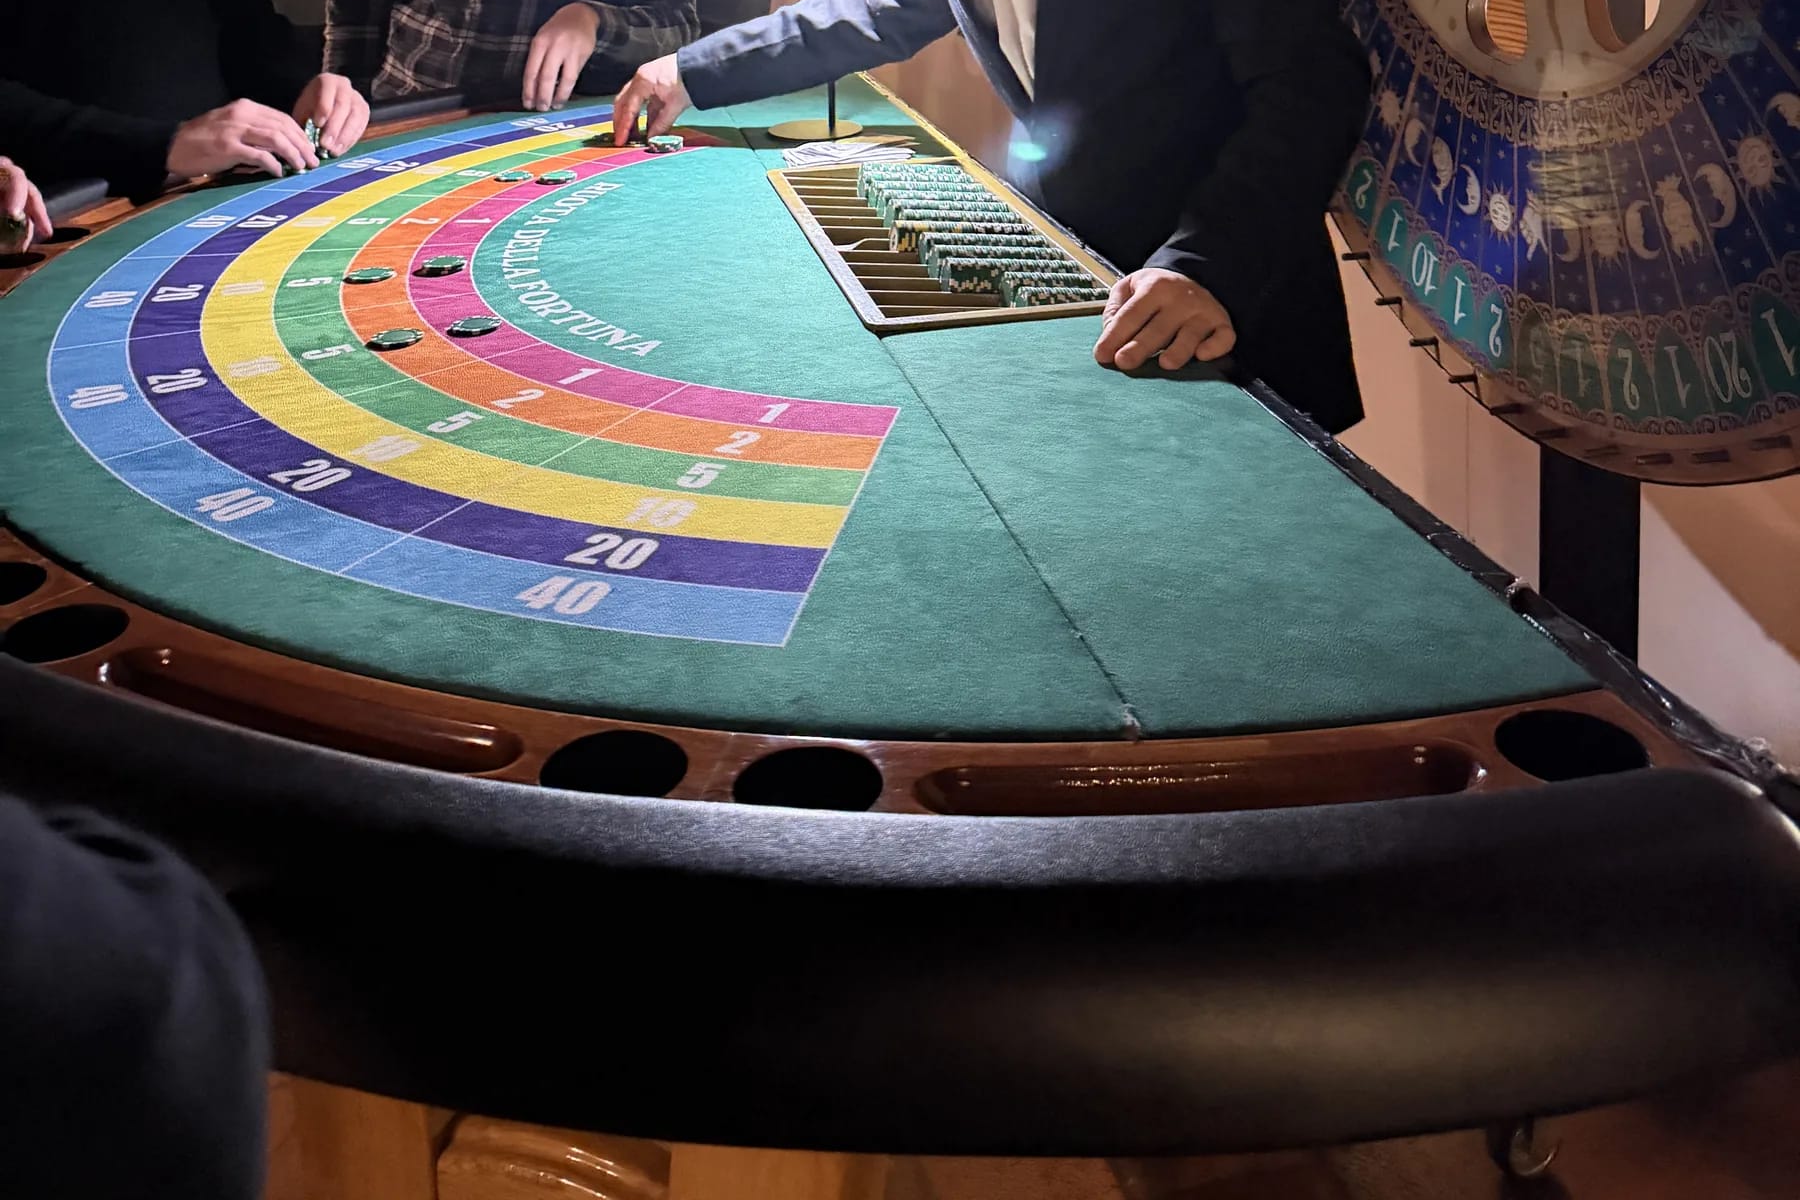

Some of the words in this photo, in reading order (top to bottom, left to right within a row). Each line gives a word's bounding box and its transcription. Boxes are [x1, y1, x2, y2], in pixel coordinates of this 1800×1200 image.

[533, 122, 575, 133] 20
[373, 160, 419, 172] 20
[524, 181, 625, 226] RUOTA
[236, 214, 288, 229] 20
[346, 217, 391, 226] 5
[401, 217, 442, 226] 2
[454, 217, 493, 225] 1
[1387, 208, 1403, 252] 1
[502, 228, 550, 280] DELLA
[1412, 241, 1439, 296] 10
[151, 284, 204, 302] 20
[286, 276, 334, 288] 5
[84, 291, 138, 309] 40
[1454, 275, 1467, 325] 1
[509, 279, 663, 357] FORTUNA
[1489, 303, 1503, 358] 2
[301, 343, 357, 360] 5
[1760, 308, 1796, 377] 1
[557, 368, 604, 385] 1
[1617, 349, 1640, 410] 2
[1664, 346, 1691, 408] 1
[1704, 330, 1751, 403] 20
[146, 368, 208, 394] 20
[67, 384, 129, 409] 40
[491, 388, 544, 409] 2
[426, 410, 485, 433] 5
[758, 402, 791, 423] 1
[714, 430, 761, 454] 2
[268, 458, 352, 492] 20
[676, 462, 727, 489] 5
[195, 488, 275, 522] 40
[622, 495, 698, 529] 10
[565, 533, 660, 570] 20
[515, 576, 612, 615] 40
